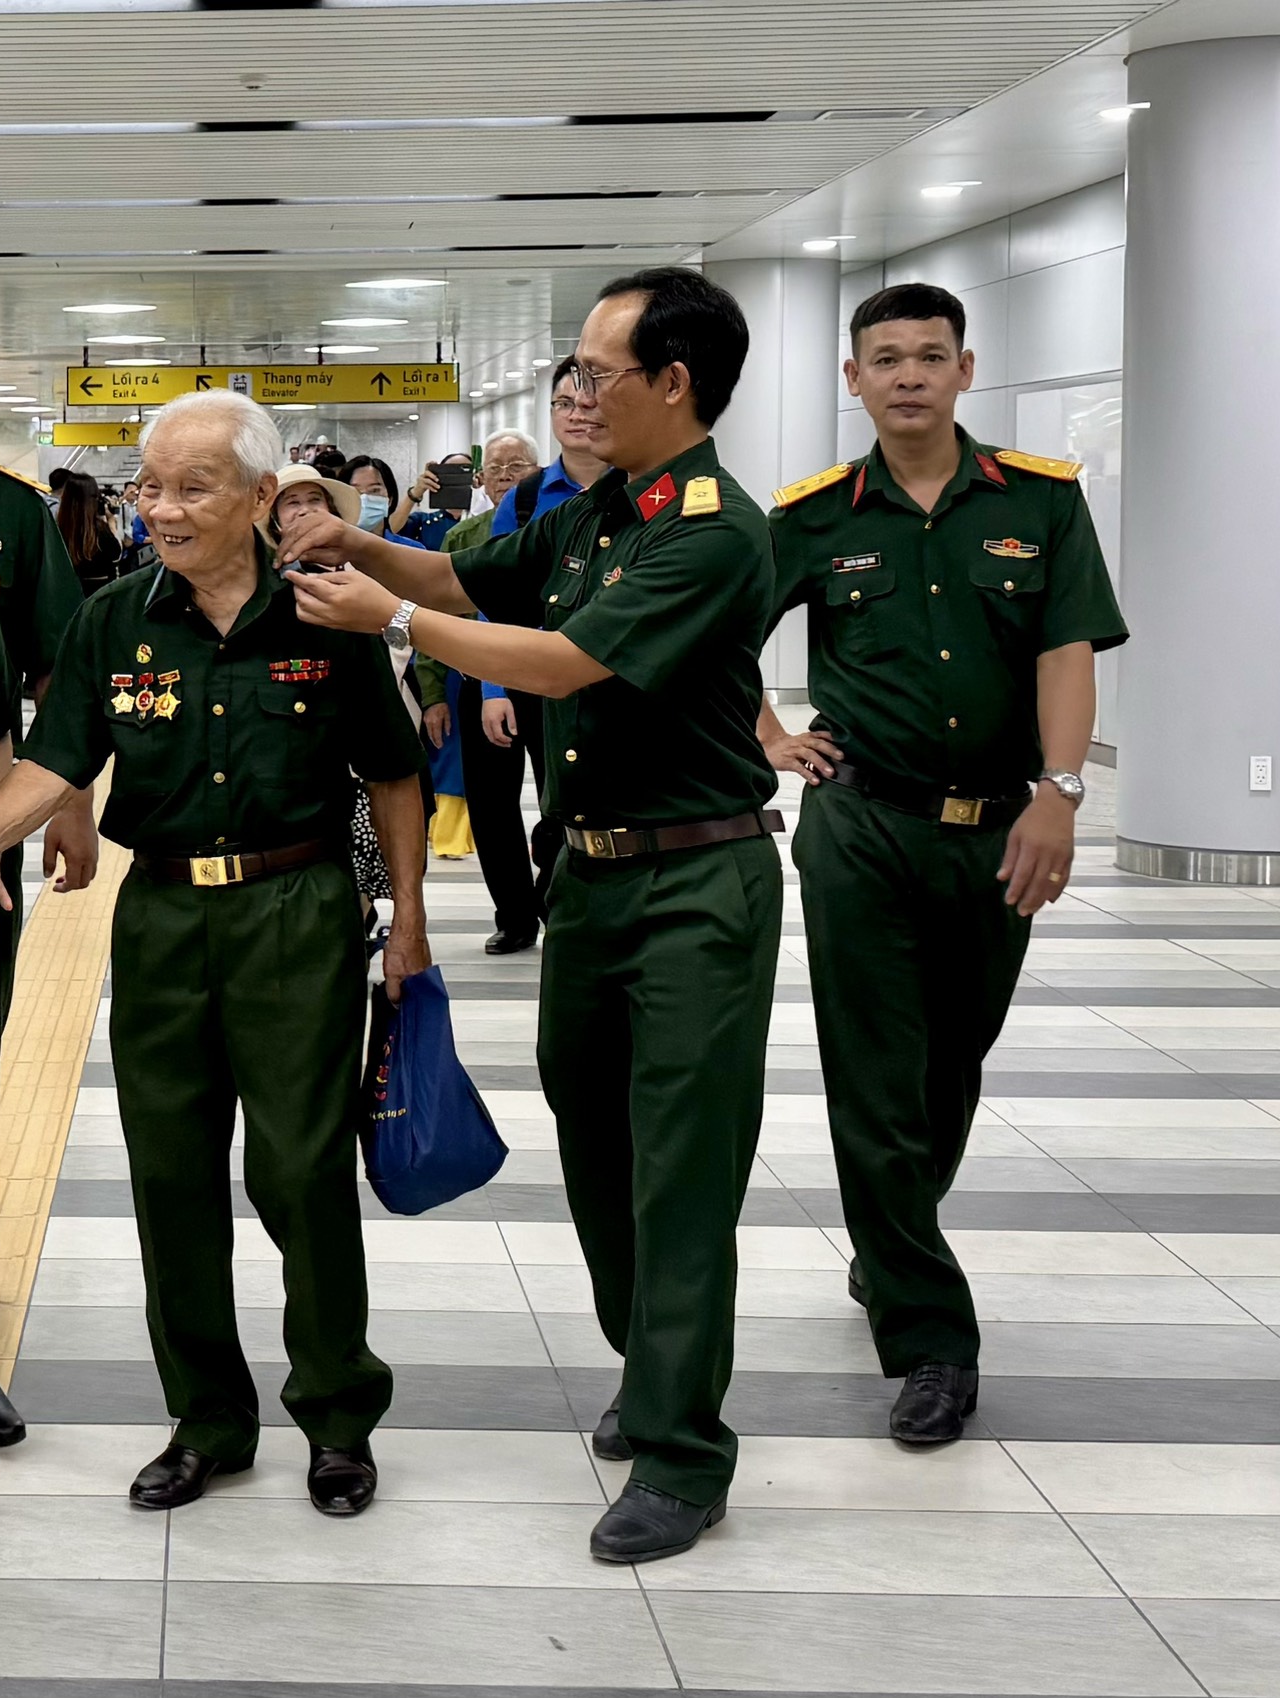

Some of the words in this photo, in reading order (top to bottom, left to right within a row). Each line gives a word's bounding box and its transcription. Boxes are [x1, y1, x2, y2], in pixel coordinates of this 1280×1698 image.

[112, 372, 132, 385] Lối
[135, 376, 148, 385] ra
[151, 373, 160, 385] 4
[263, 372, 302, 387] Thang
[306, 371, 333, 386] máy
[403, 368, 423, 383] Lối
[426, 373, 439, 383] ra
[443, 370, 449, 382] 1
[112, 389, 129, 398] Exit
[131, 389, 137, 398] 4
[262, 388, 299, 397] Elevator
[403, 386, 420, 396] Exit
[421, 386, 426, 396] 1
